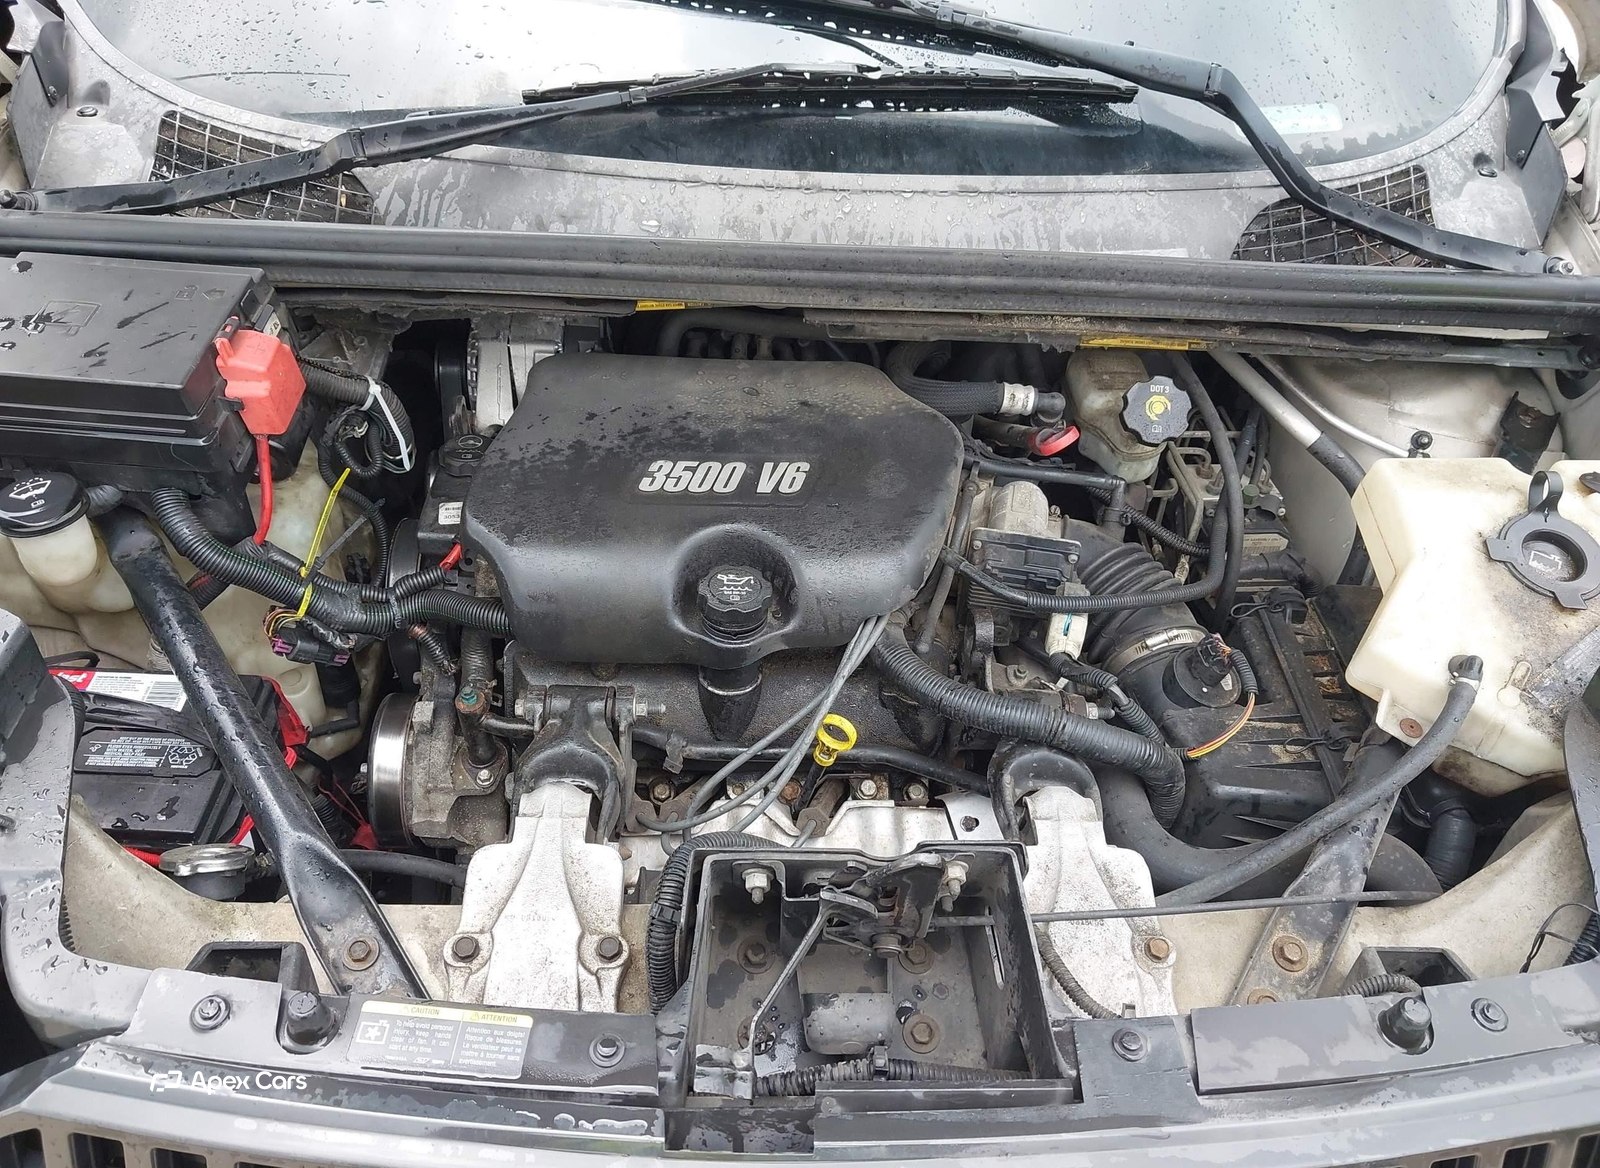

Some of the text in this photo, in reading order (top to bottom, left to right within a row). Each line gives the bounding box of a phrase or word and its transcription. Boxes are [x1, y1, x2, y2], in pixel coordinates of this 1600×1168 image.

[638, 459, 811, 495] 3500 V6
[411, 1007, 440, 1015] CAUTION
[481, 1014, 518, 1024] ATTENTION
[431, 1023, 454, 1032] personal
[466, 1026, 491, 1035] Attention
[415, 1029, 430, 1038] keep
[435, 1031, 452, 1039] hands
[464, 1034, 484, 1043] Risque
[408, 1045, 420, 1054] any
[471, 1043, 500, 1051] ventilateur
[500, 1046, 514, 1054] peut
